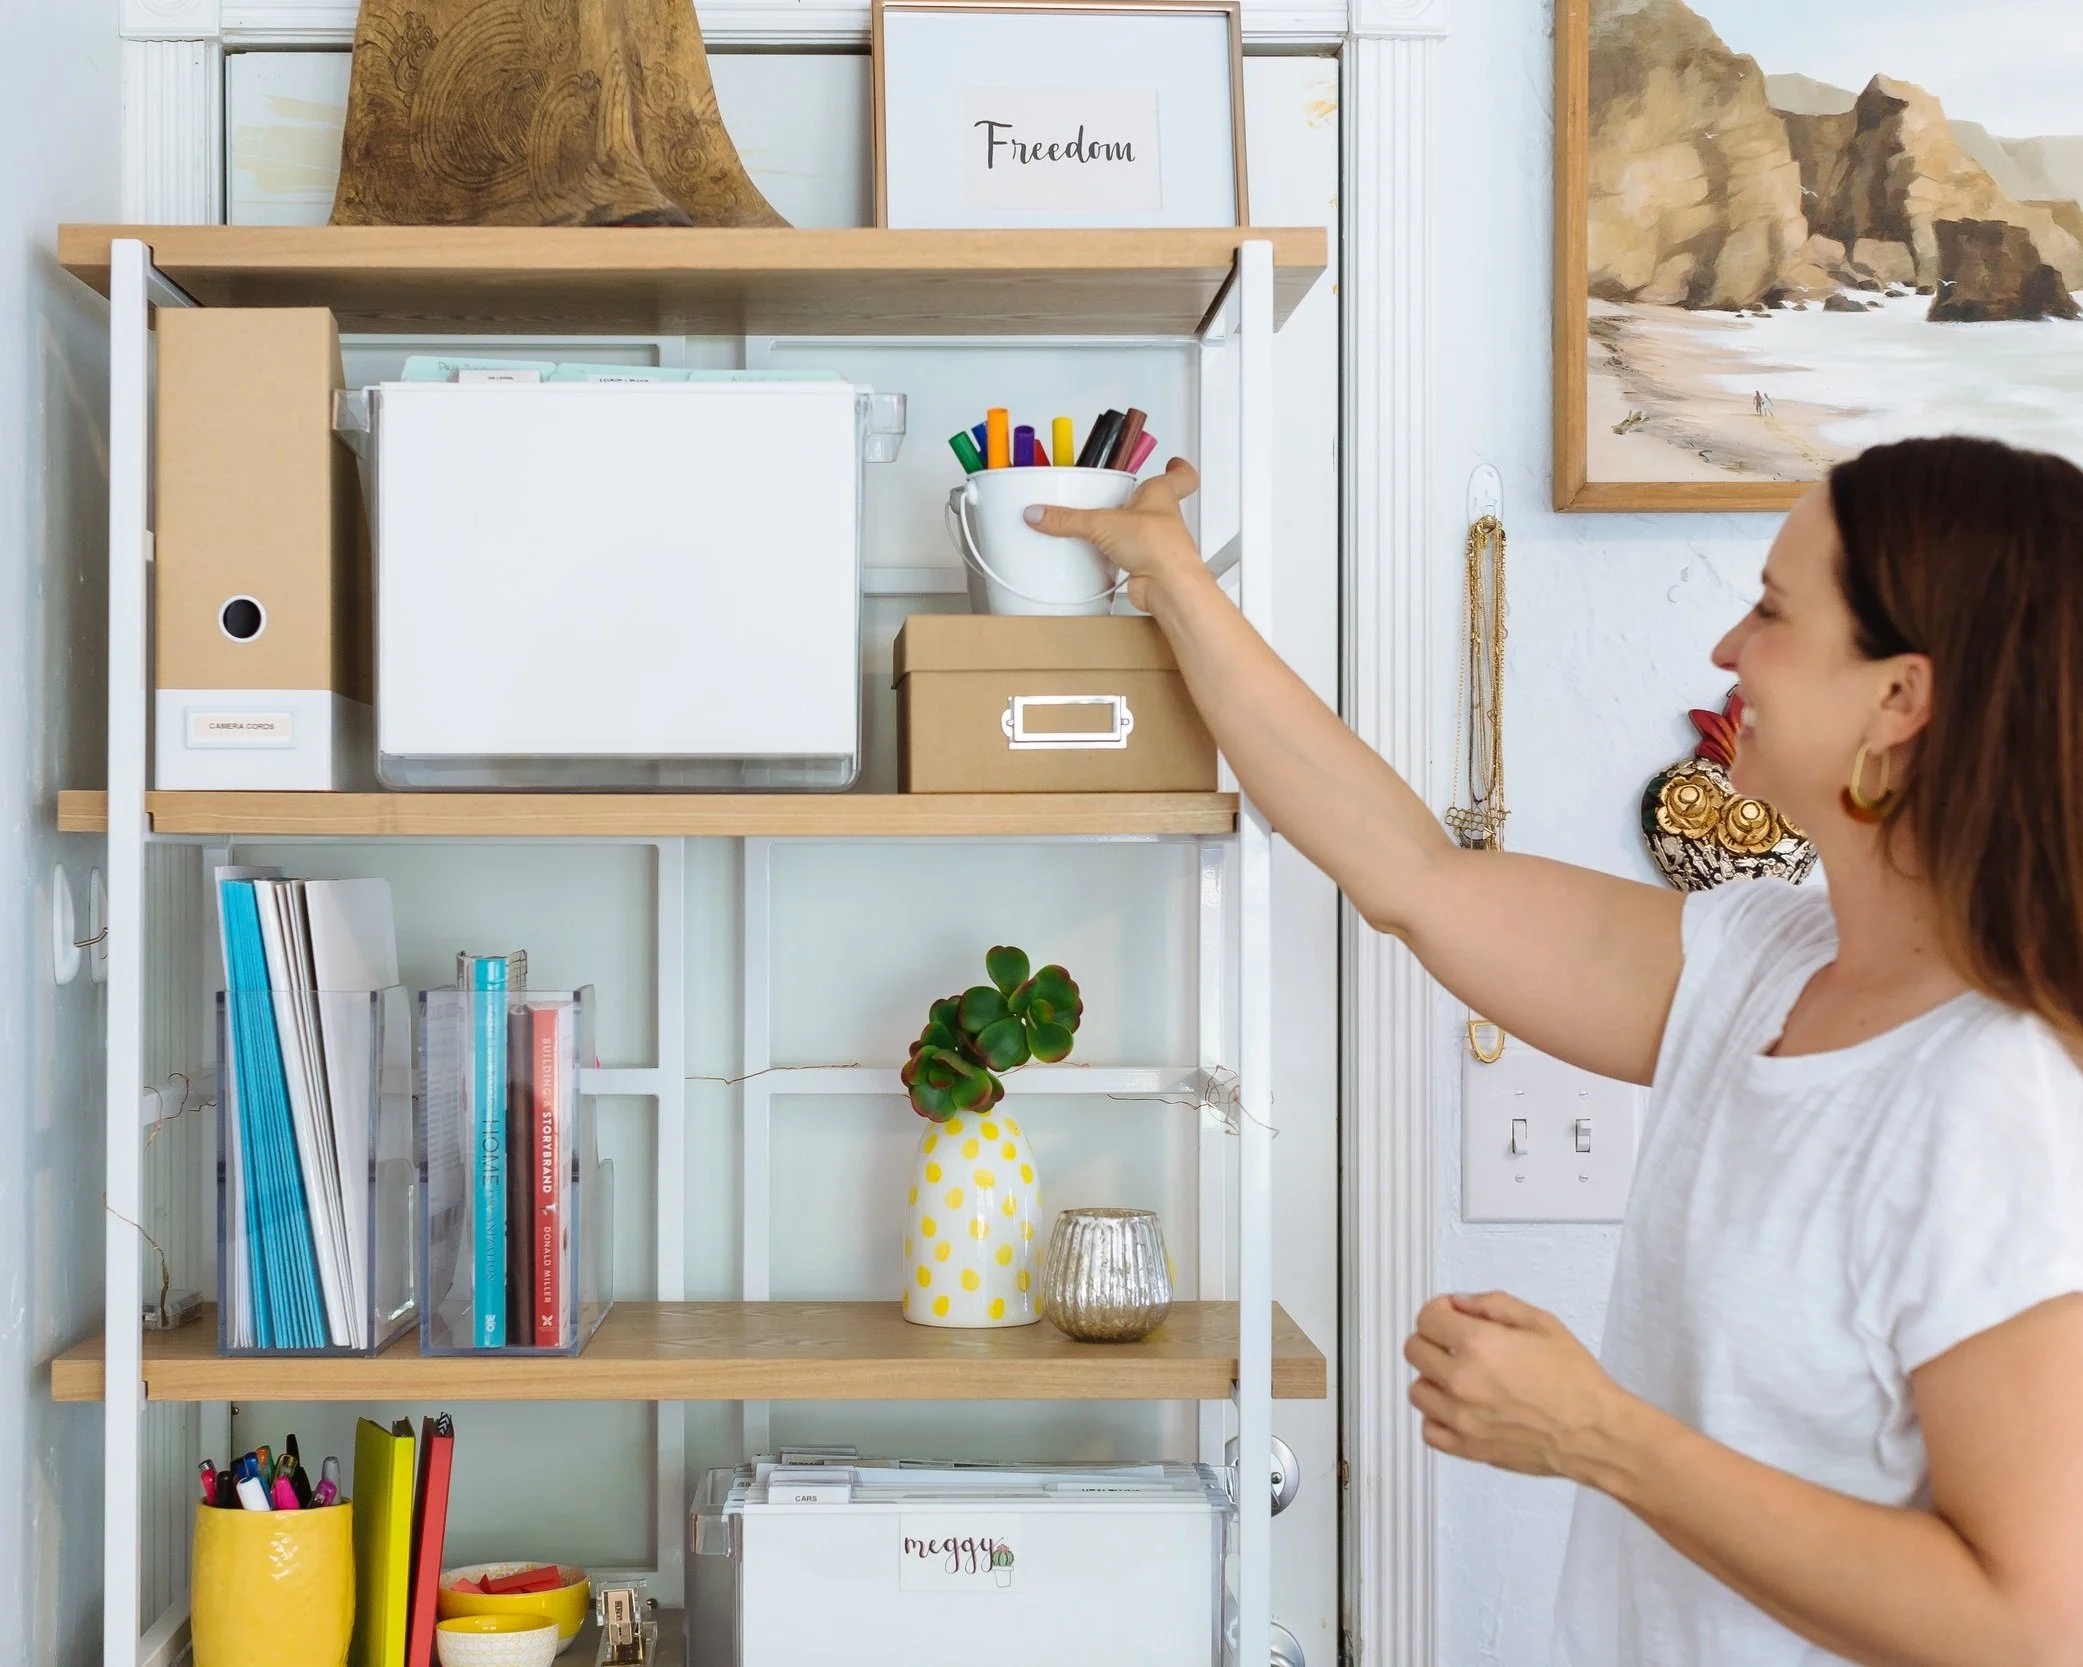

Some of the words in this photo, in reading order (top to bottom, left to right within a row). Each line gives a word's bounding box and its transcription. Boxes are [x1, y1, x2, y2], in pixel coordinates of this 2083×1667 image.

[974, 120, 1135, 169] Freedom
[208, 722, 244, 730] CAMERA
[245, 722, 275, 730] CORDS
[542, 1038, 551, 1095] BUILDING
[542, 1099, 551, 1108] A
[482, 1120, 499, 1186] HOME
[542, 1112, 552, 1193] STORYBRAND
[486, 1190, 497, 1282] ORANIZATION
[543, 1226, 552, 1267] DONALD
[543, 1270, 552, 1303] MILLER
[904, 1536, 1004, 1575] meggy
